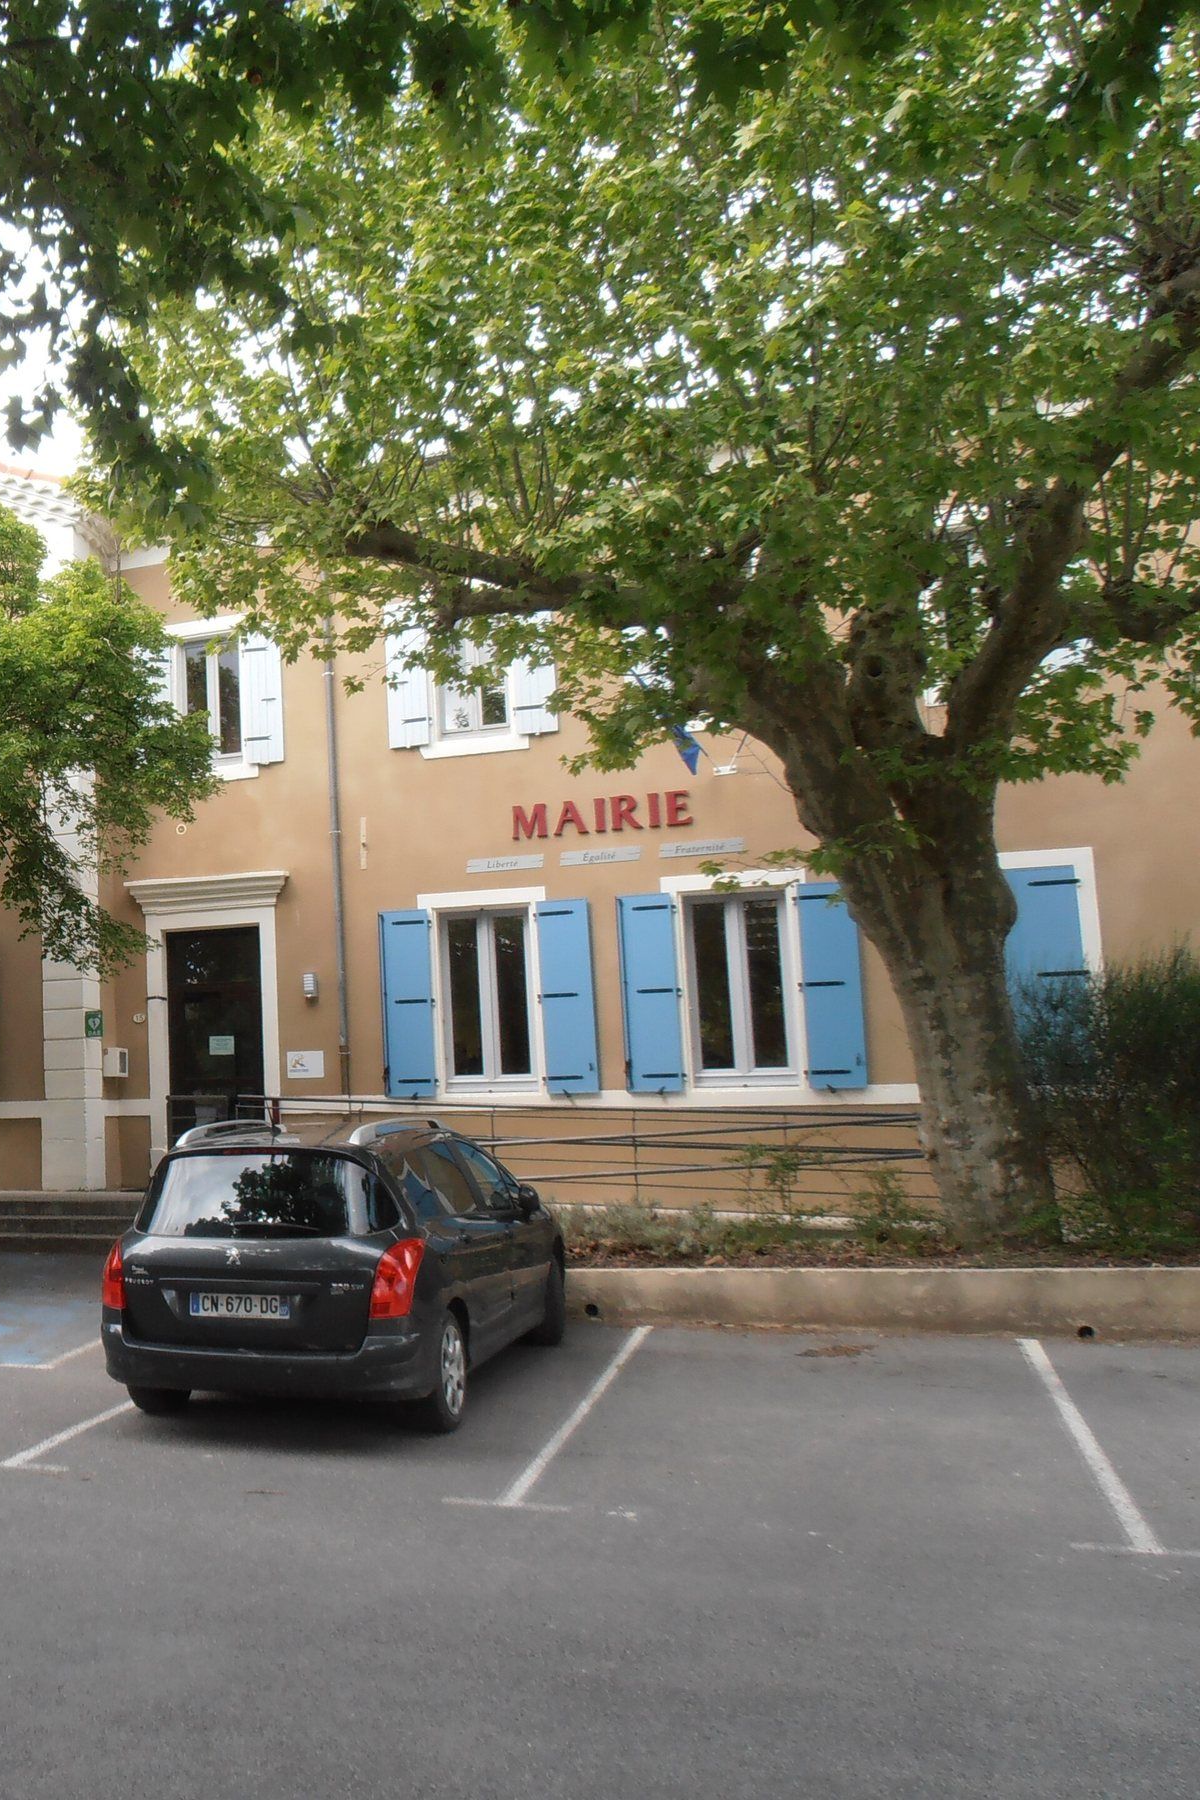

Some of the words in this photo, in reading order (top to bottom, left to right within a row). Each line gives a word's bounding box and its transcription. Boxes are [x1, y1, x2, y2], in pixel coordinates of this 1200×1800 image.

[511, 789, 694, 840] MAIRIE
[674, 843, 726, 854] Fraternité
[582, 851, 616, 863] Égalité
[486, 859, 519, 869] Liberté
[201, 1294, 279, 1314] CN-670-DG
